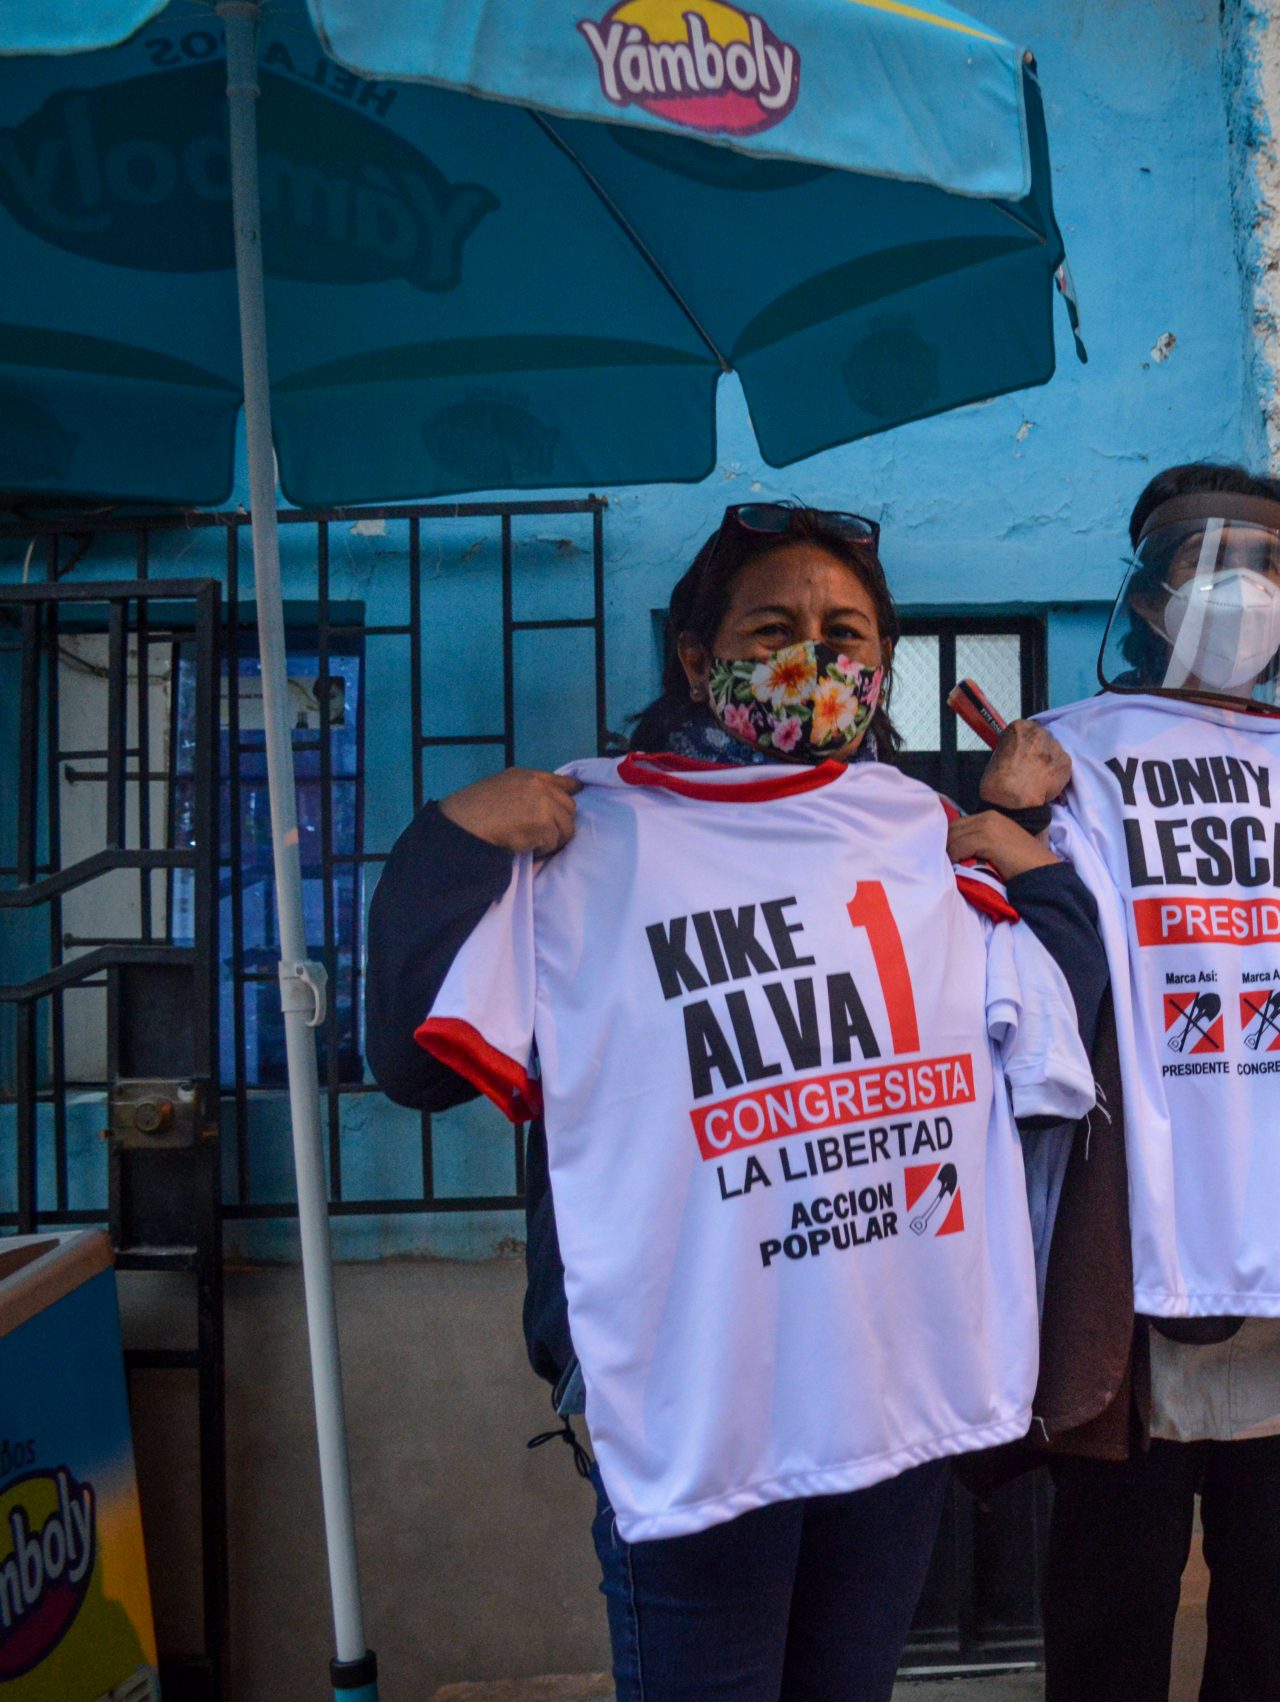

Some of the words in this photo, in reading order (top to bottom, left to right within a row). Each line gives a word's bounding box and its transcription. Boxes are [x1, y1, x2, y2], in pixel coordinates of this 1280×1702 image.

[1105, 755, 1271, 809] YONHY
[645, 896, 815, 1001] KIKE
[846, 880, 920, 1054] 1
[1166, 971, 1197, 984] Marca
[1242, 970, 1271, 983] Marca
[683, 972, 881, 1099] ALVA
[1162, 1061, 1230, 1077] PRESIDENTE
[704, 1061, 970, 1149] CONGRESISTA
[717, 1155, 771, 1200] LA
[780, 1116, 953, 1182] LIBERTAD
[791, 1182, 893, 1230] ACCION
[760, 1212, 898, 1267] POPULAR
